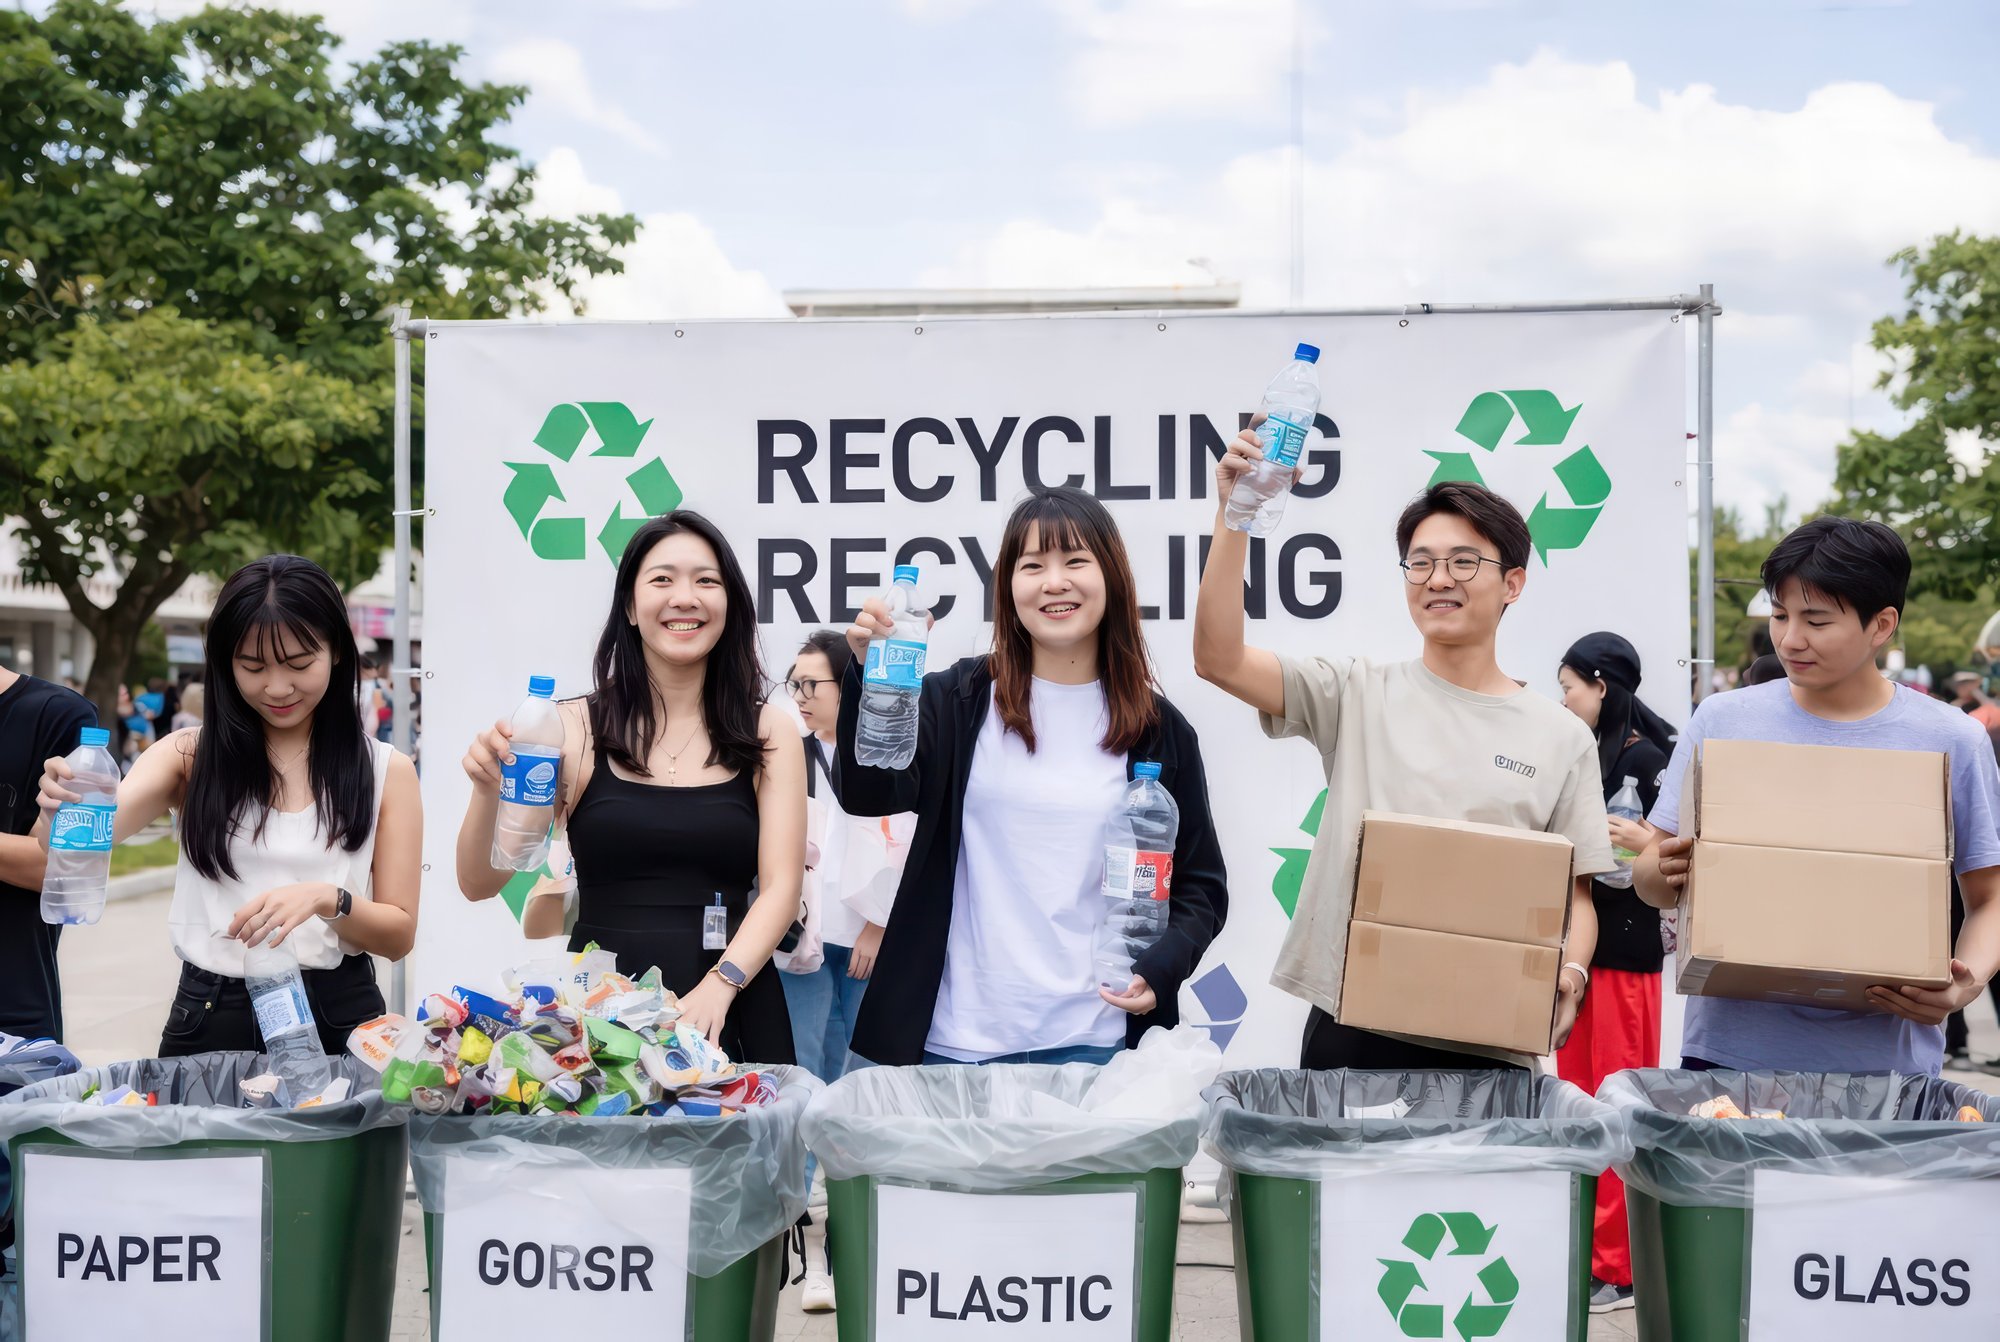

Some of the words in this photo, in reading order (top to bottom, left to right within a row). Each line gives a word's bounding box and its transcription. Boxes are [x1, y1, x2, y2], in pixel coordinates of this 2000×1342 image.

[57, 1232, 222, 1283] PAPER
[478, 1238, 655, 1292] GORSR
[1793, 1253, 1971, 1307] GLASS
[896, 1268, 1113, 1323] PLASTIC
